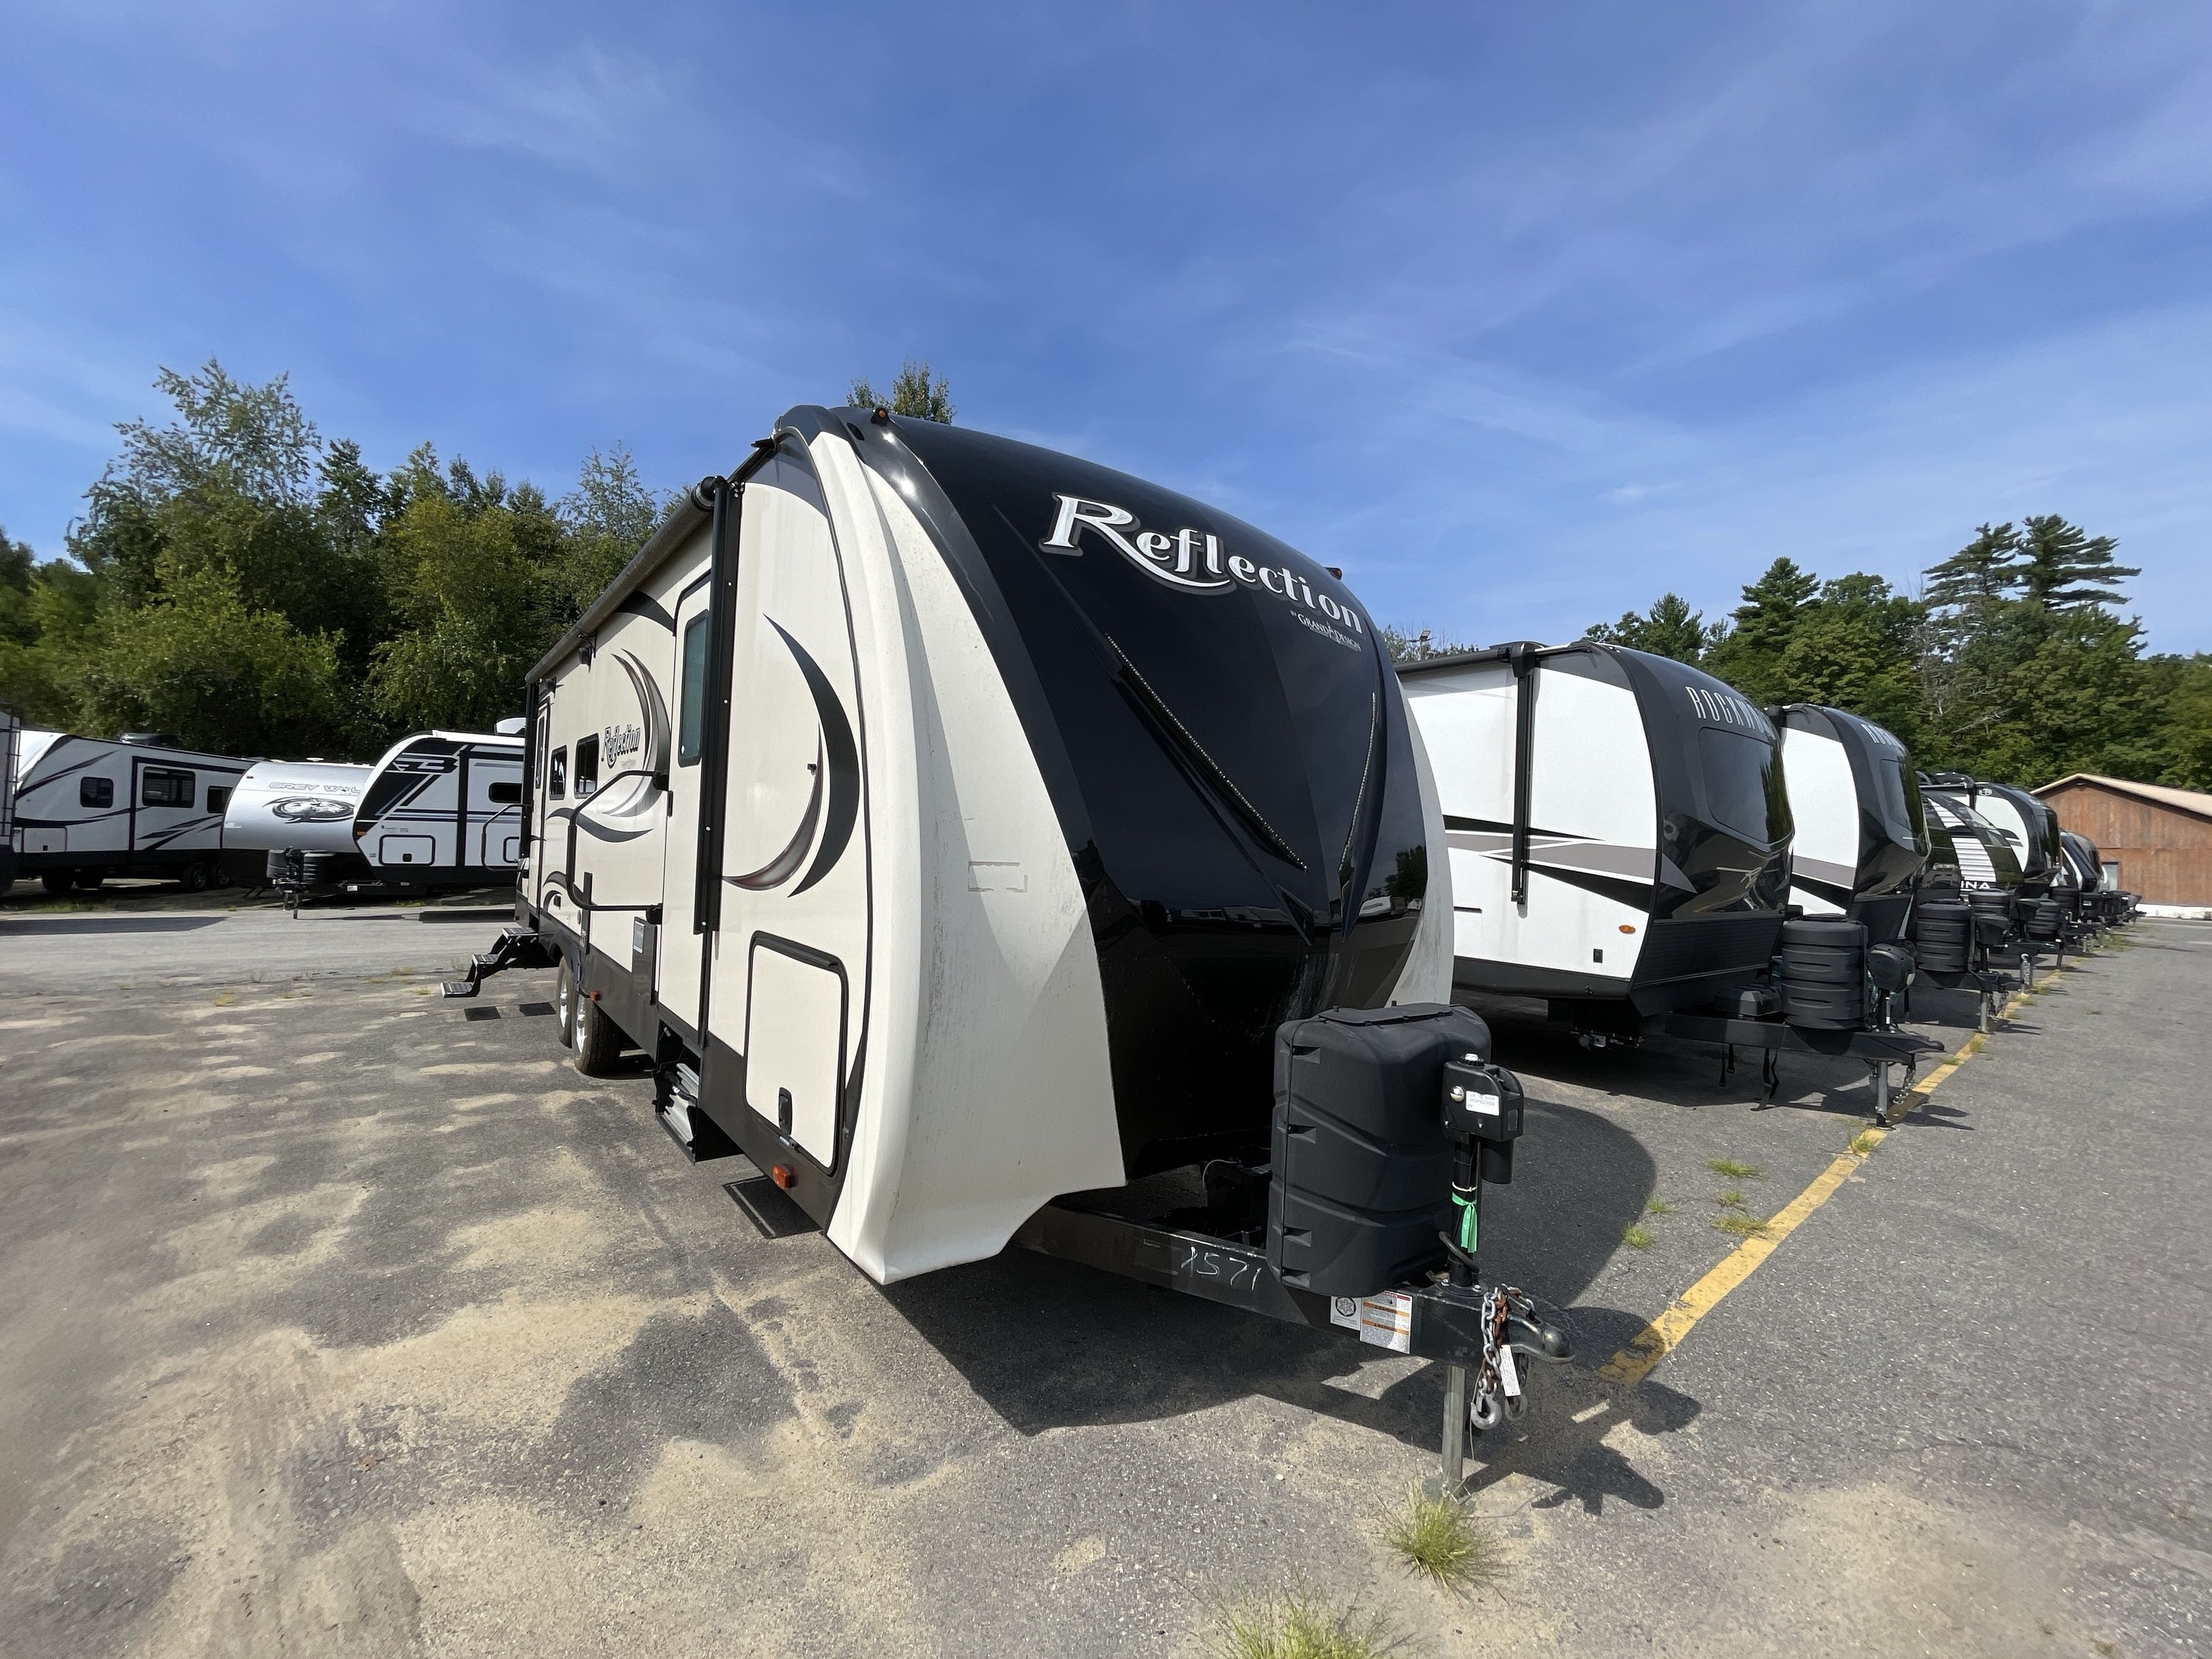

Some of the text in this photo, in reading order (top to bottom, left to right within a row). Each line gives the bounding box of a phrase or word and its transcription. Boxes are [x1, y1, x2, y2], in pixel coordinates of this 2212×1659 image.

[1039, 493, 1363, 634] Reflection
[1298, 613, 1329, 634] GRAND
[1333, 629, 1362, 652] DESIGN
[1685, 686, 1776, 740] ROCKWO
[601, 723, 640, 769] Reflection
[269, 782, 319, 790] GREY
